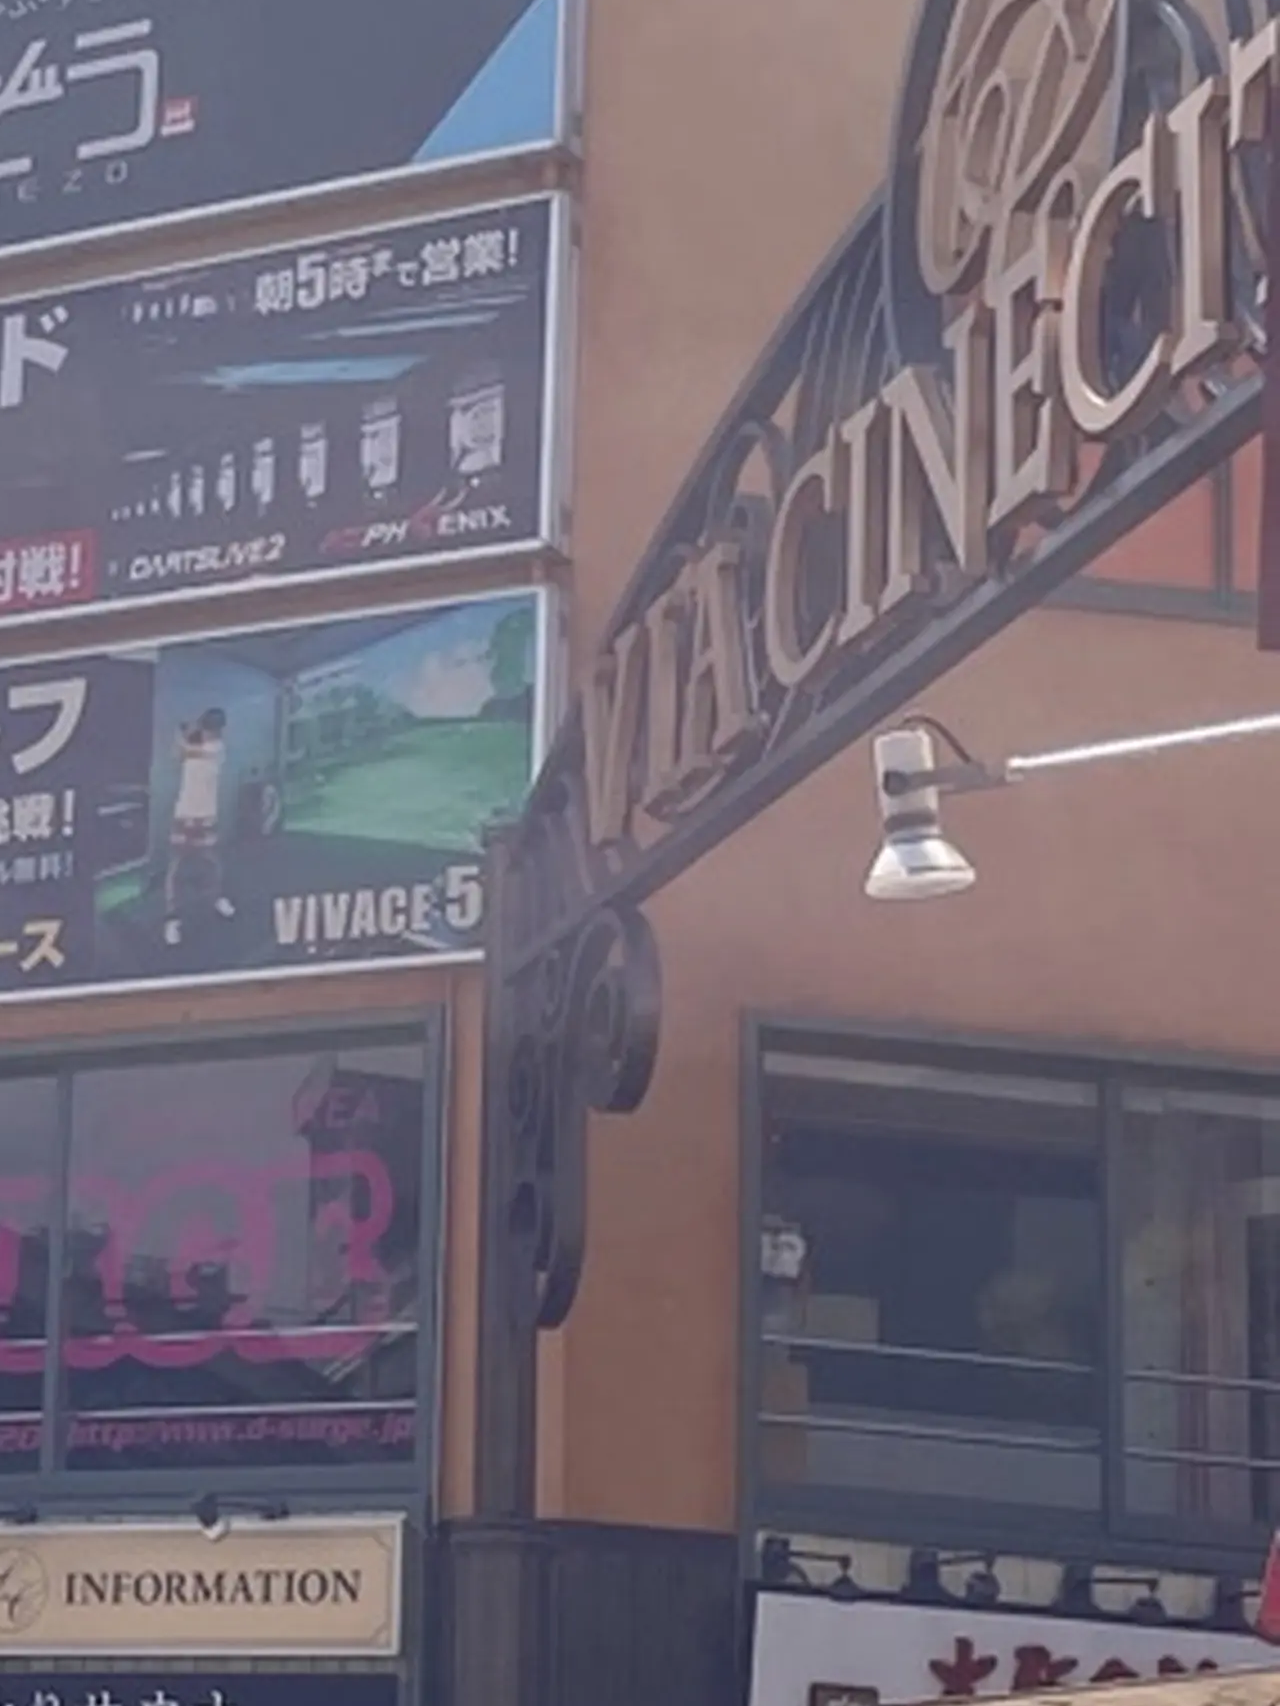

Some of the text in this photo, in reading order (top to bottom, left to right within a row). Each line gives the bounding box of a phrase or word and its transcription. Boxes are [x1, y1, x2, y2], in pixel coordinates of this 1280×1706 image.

[580, 541, 770, 845] VIA
[273, 865, 483, 945] VIVACE 5
[64, 1569, 362, 1607] INFORMATION
